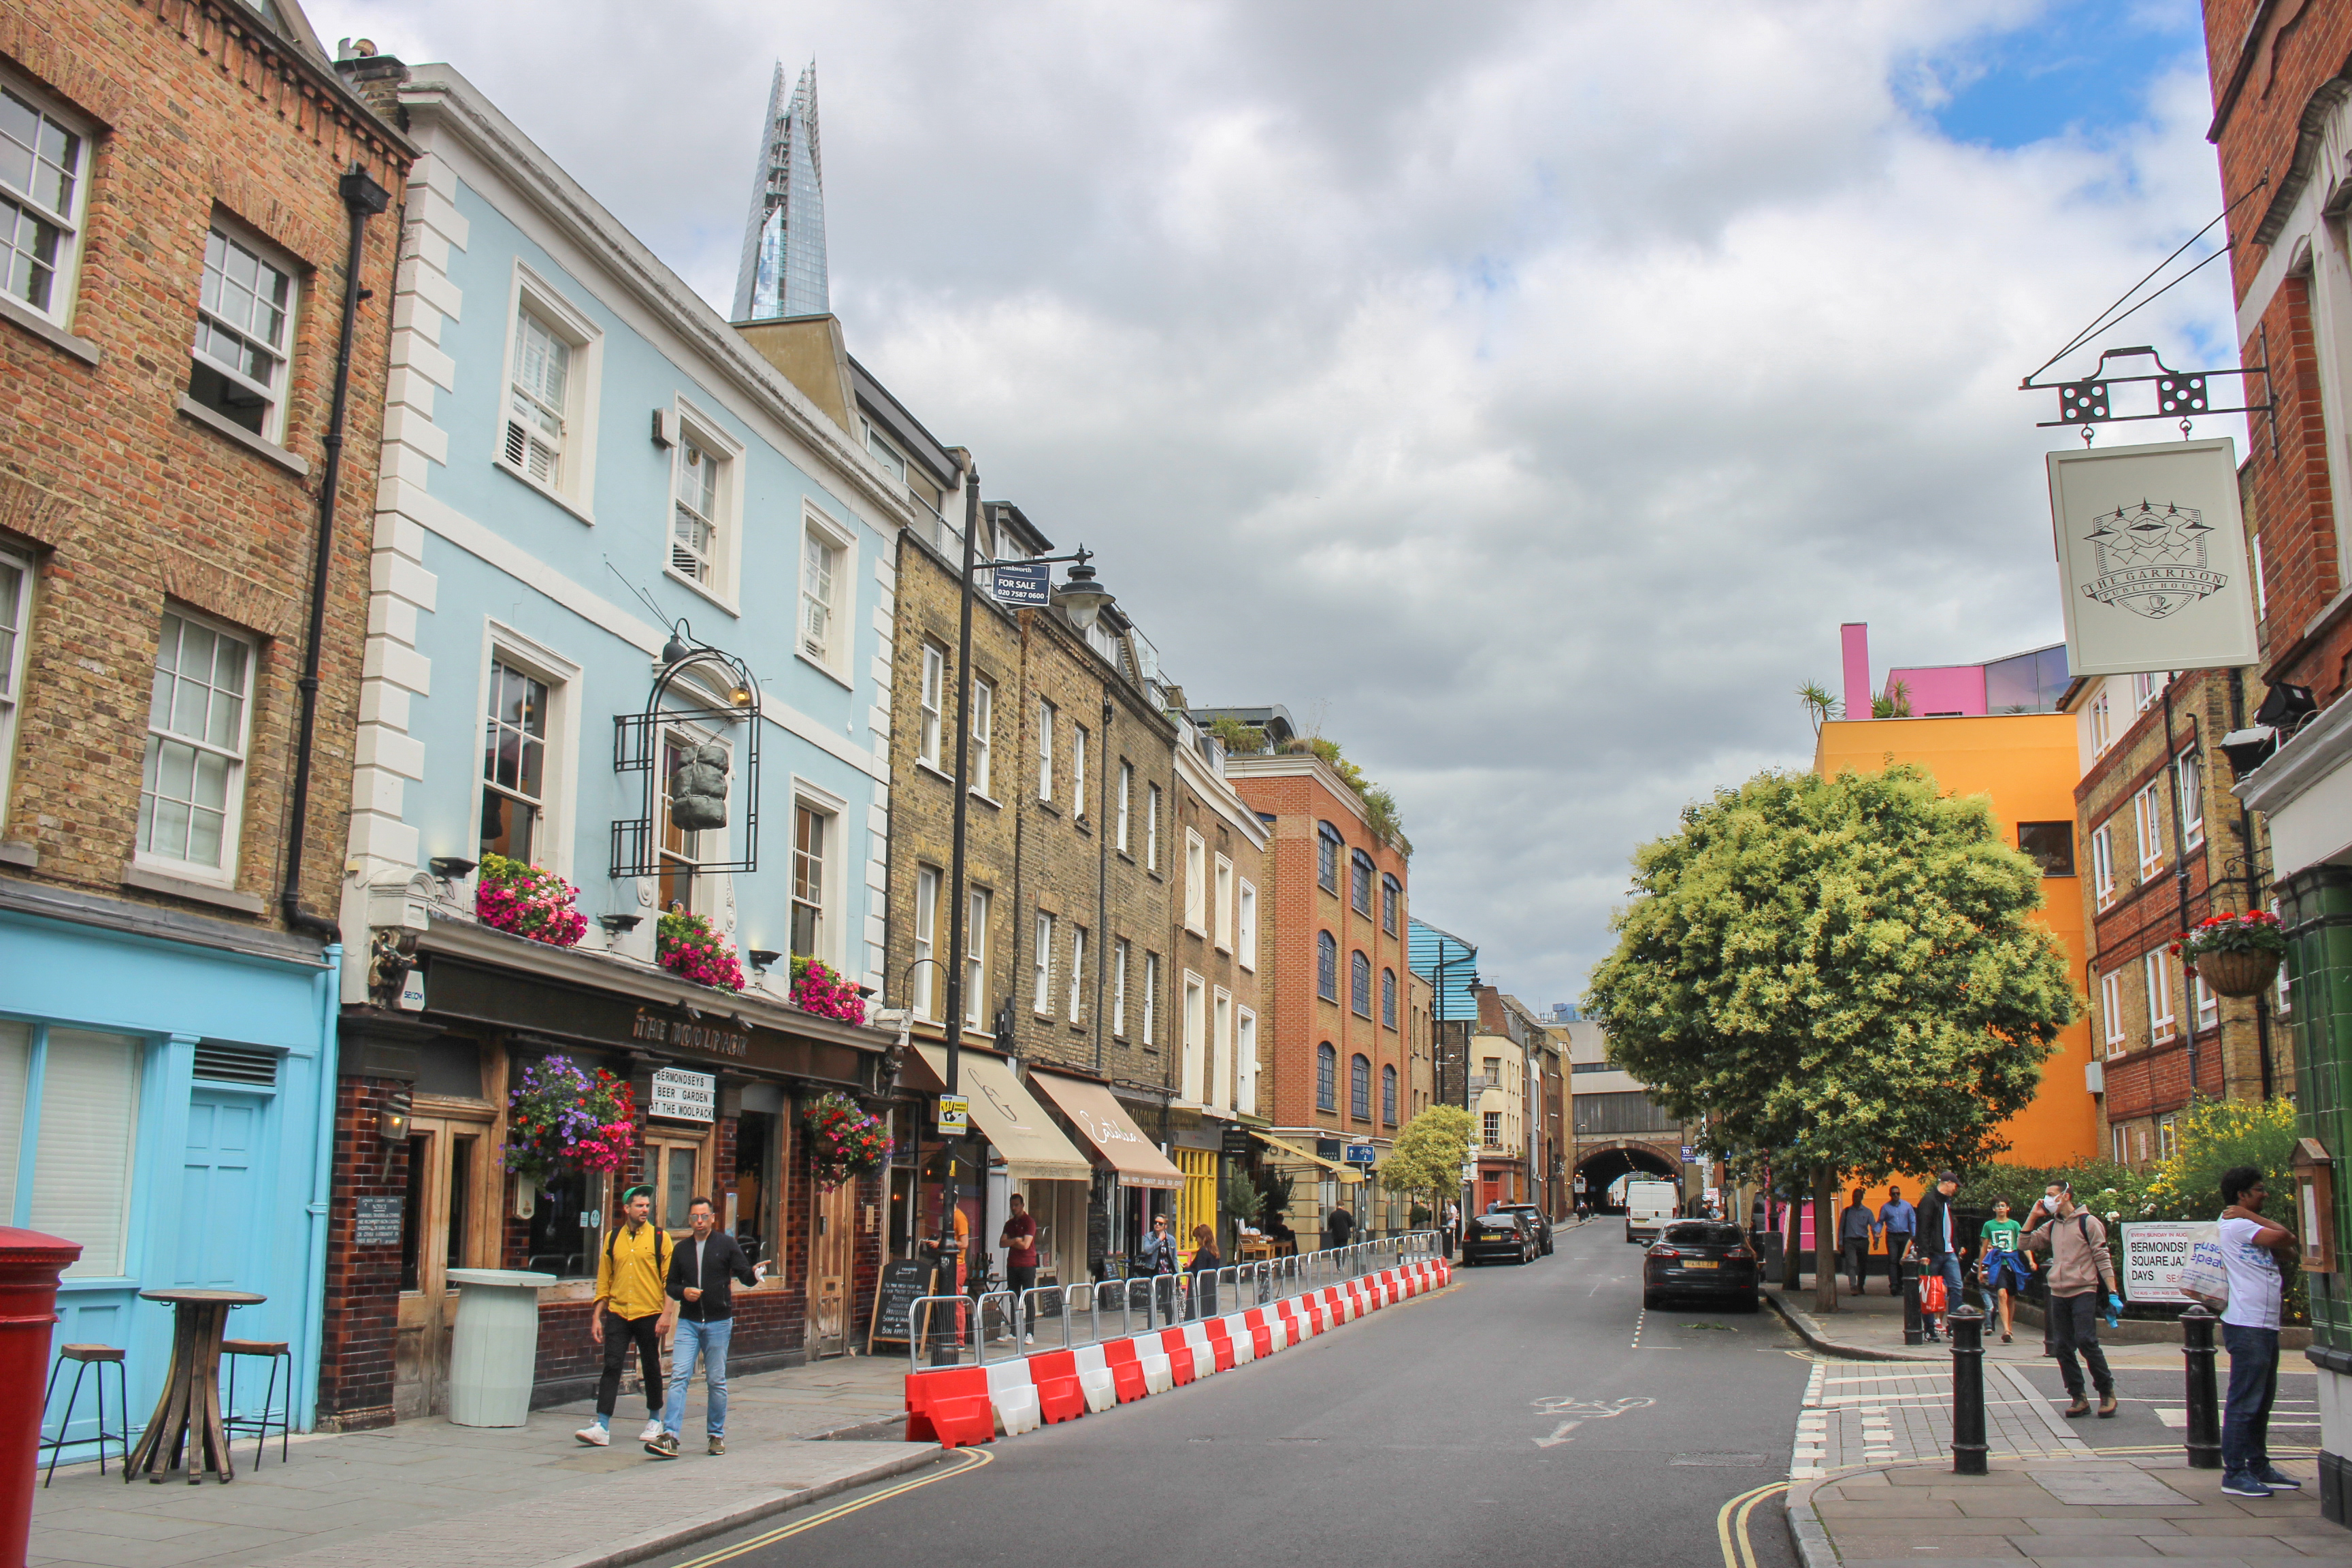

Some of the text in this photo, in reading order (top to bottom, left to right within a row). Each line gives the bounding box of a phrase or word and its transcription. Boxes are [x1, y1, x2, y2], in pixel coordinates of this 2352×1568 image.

[998, 578, 1036, 590] FOR SALE
[2086, 569, 2221, 593] THE GARRISON
[1011, 590, 1027, 598] 7587
[1028, 591, 1044, 600] 0600
[2104, 583, 2207, 599] PUBLIC HOUSE
[404, 991, 423, 1000] SECOM
[634, 1015, 748, 1056] THE WOOLPACK
[657, 1071, 704, 1087] BERMONDSEYS
[657, 1087, 708, 1102] BEER GARDEN
[650, 1102, 713, 1118] AT THE WOOLPACK
[2131, 1242, 2187, 1252] BERMONDS
[2132, 1256, 2185, 1266] SQUARE JA
[2132, 1270, 2154, 1280] DAYS
[882, 1326, 892, 1334] BON
